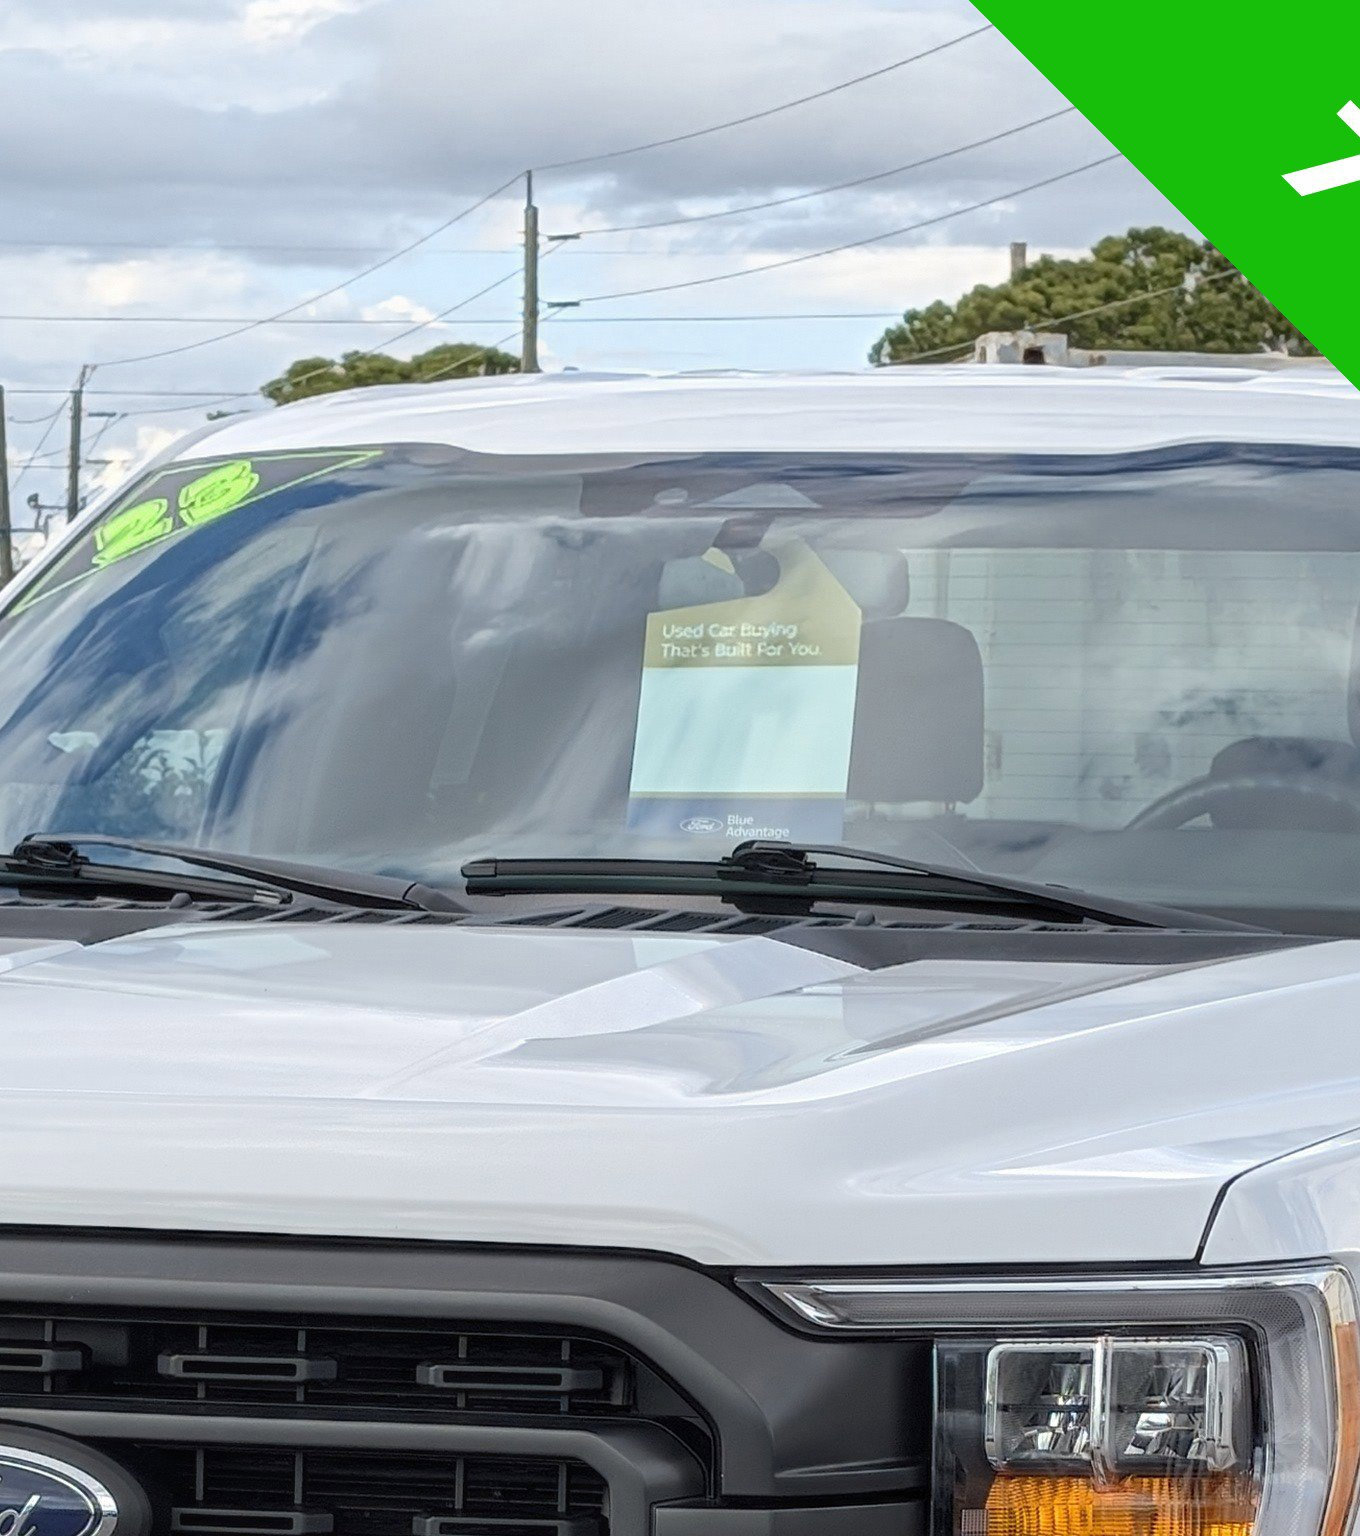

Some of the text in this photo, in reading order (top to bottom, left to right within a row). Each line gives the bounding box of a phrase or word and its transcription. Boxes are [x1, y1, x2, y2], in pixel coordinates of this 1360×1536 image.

[662, 621, 798, 639] Used Car Buying
[661, 642, 710, 658] That's
[715, 642, 752, 657] Built
[757, 643, 783, 656] For
[727, 815, 754, 826] Blue
[725, 826, 790, 839] Advantage
